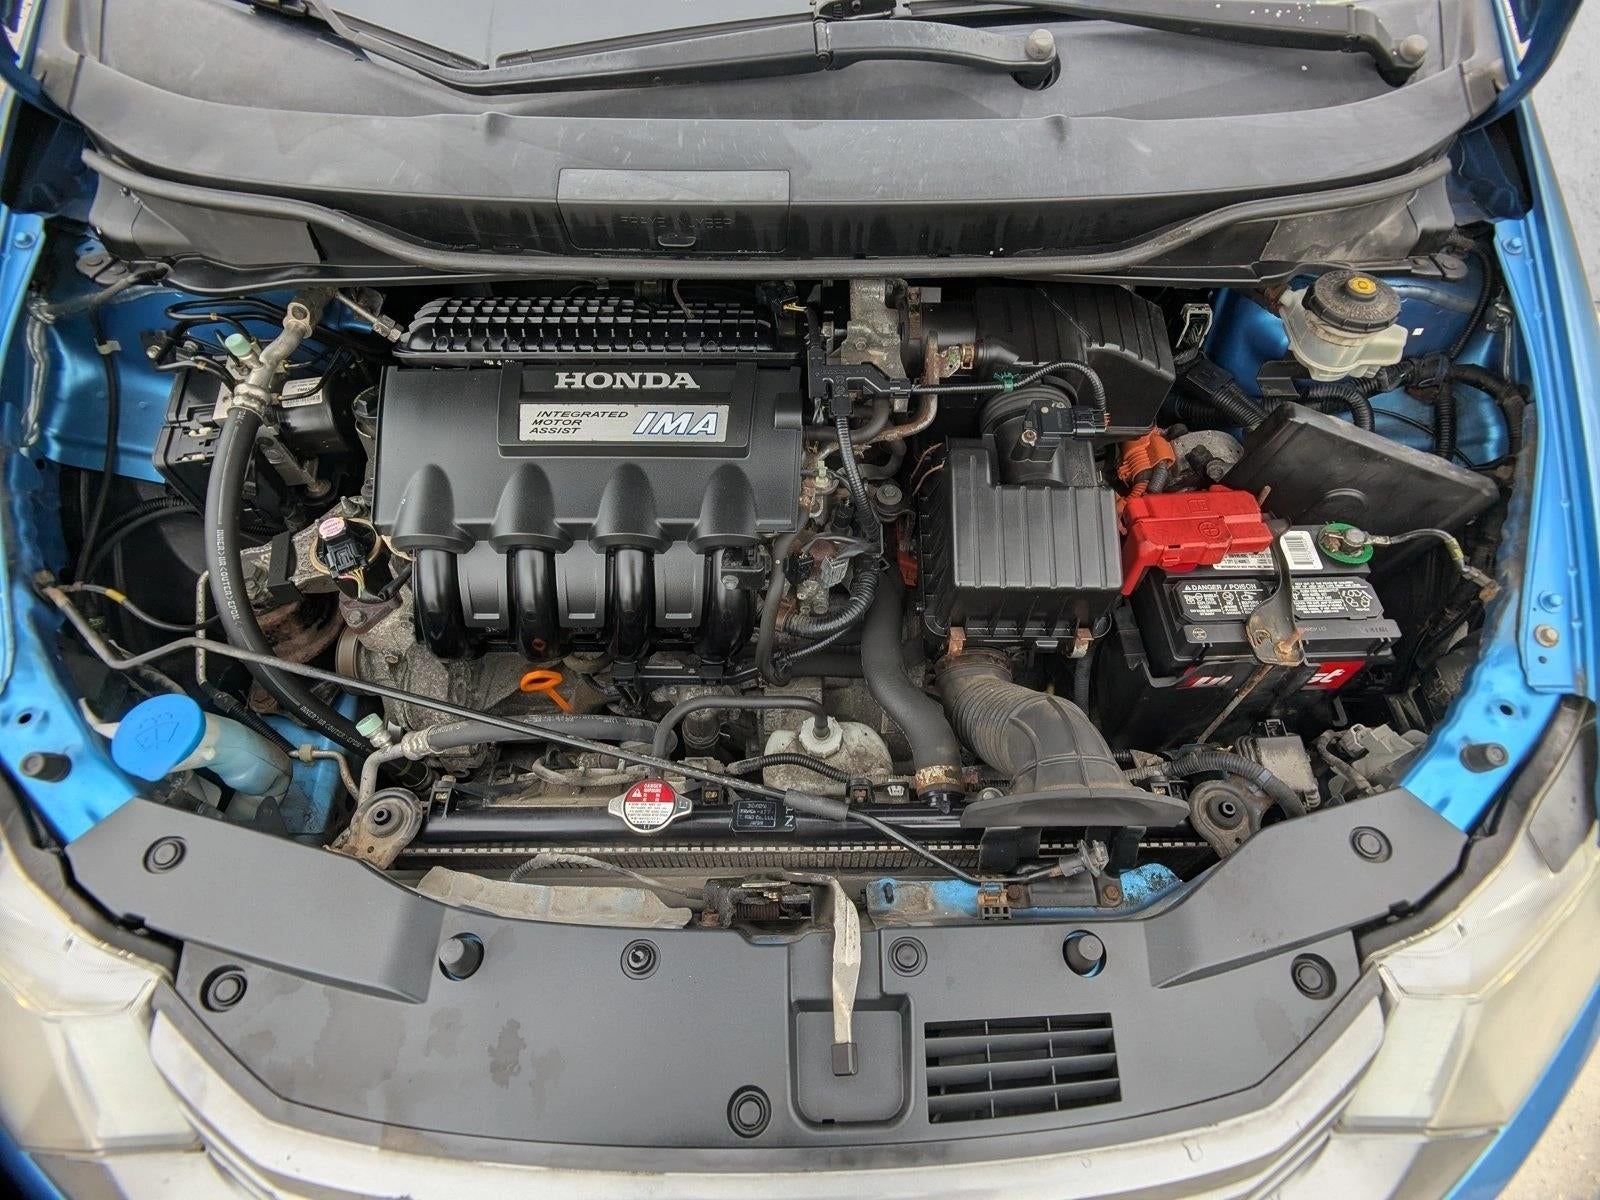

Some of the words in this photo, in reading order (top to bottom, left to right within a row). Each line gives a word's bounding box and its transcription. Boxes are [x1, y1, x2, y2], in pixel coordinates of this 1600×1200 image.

[553, 371, 701, 390] HONDA
[536, 410, 629, 418] INTEGRATED
[632, 411, 719, 436] IMA
